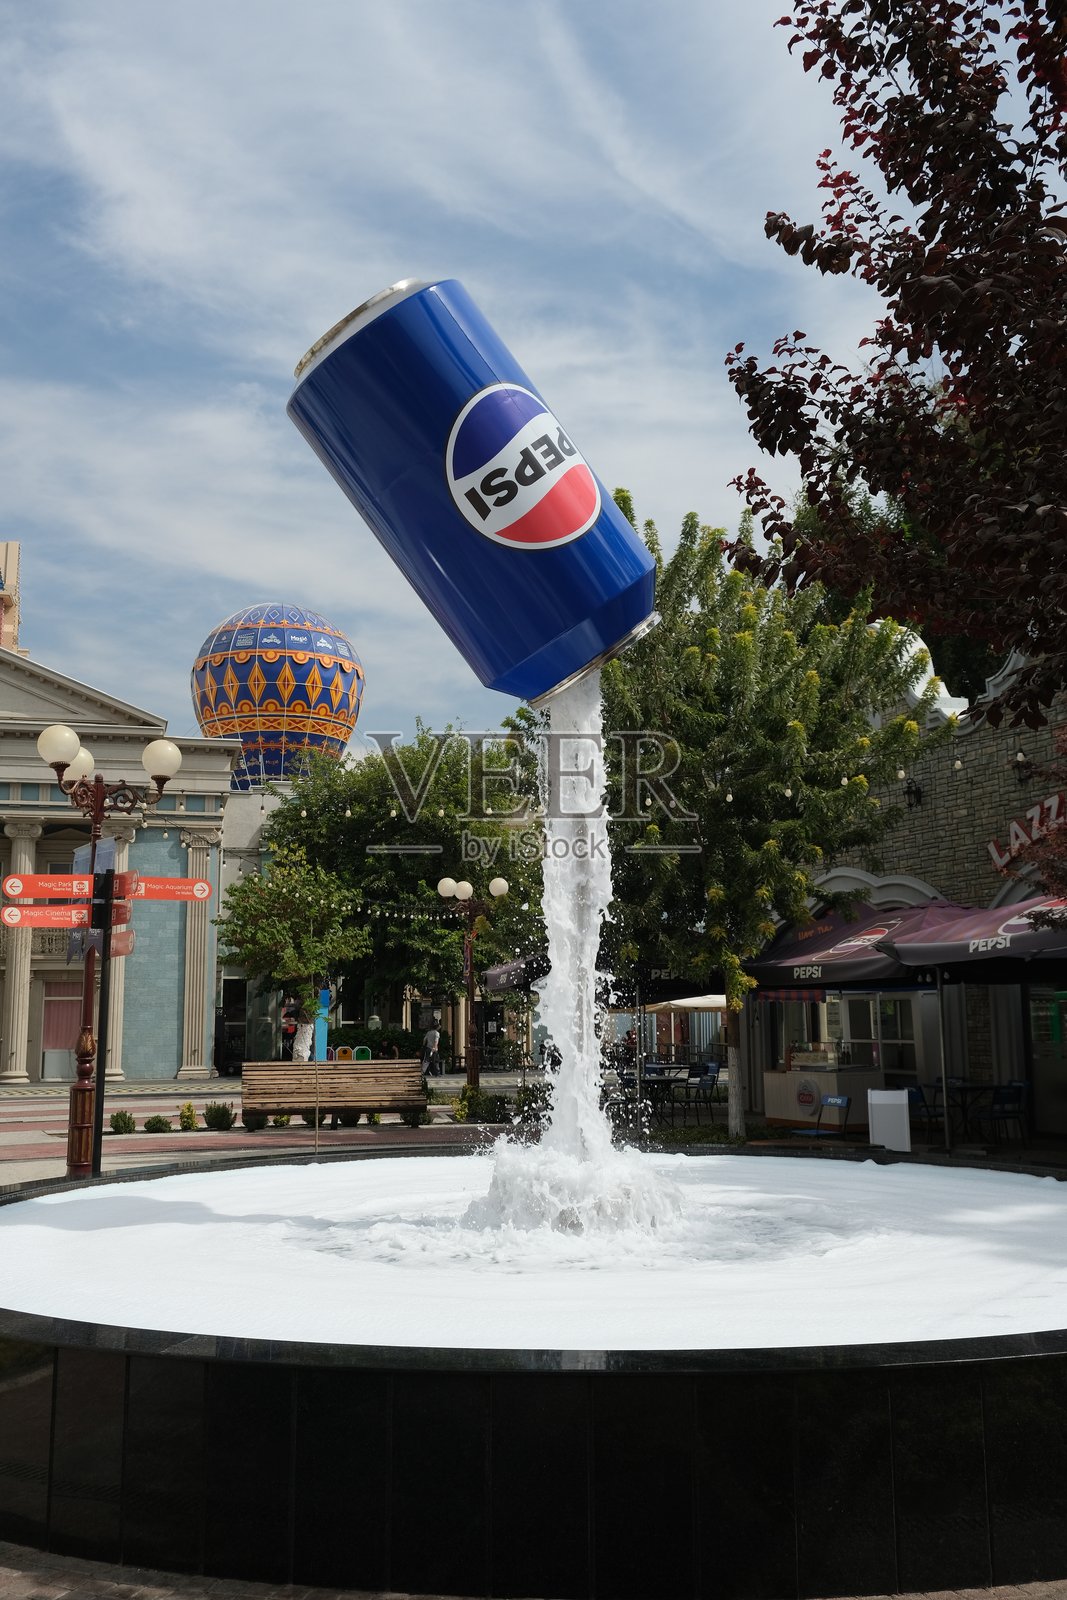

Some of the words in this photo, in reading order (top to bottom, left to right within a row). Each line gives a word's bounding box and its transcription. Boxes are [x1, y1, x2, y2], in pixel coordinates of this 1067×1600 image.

[463, 426, 577, 522] PEPSI
[38, 881, 58, 889] Magic
[146, 883, 163, 891] Magic
[23, 909, 44, 917] Magic
[969, 935, 1012, 953] PEPSI
[650, 968, 688, 980] PEP
[793, 965, 822, 979] PEPSI
[827, 1097, 843, 1105] PEPSI
